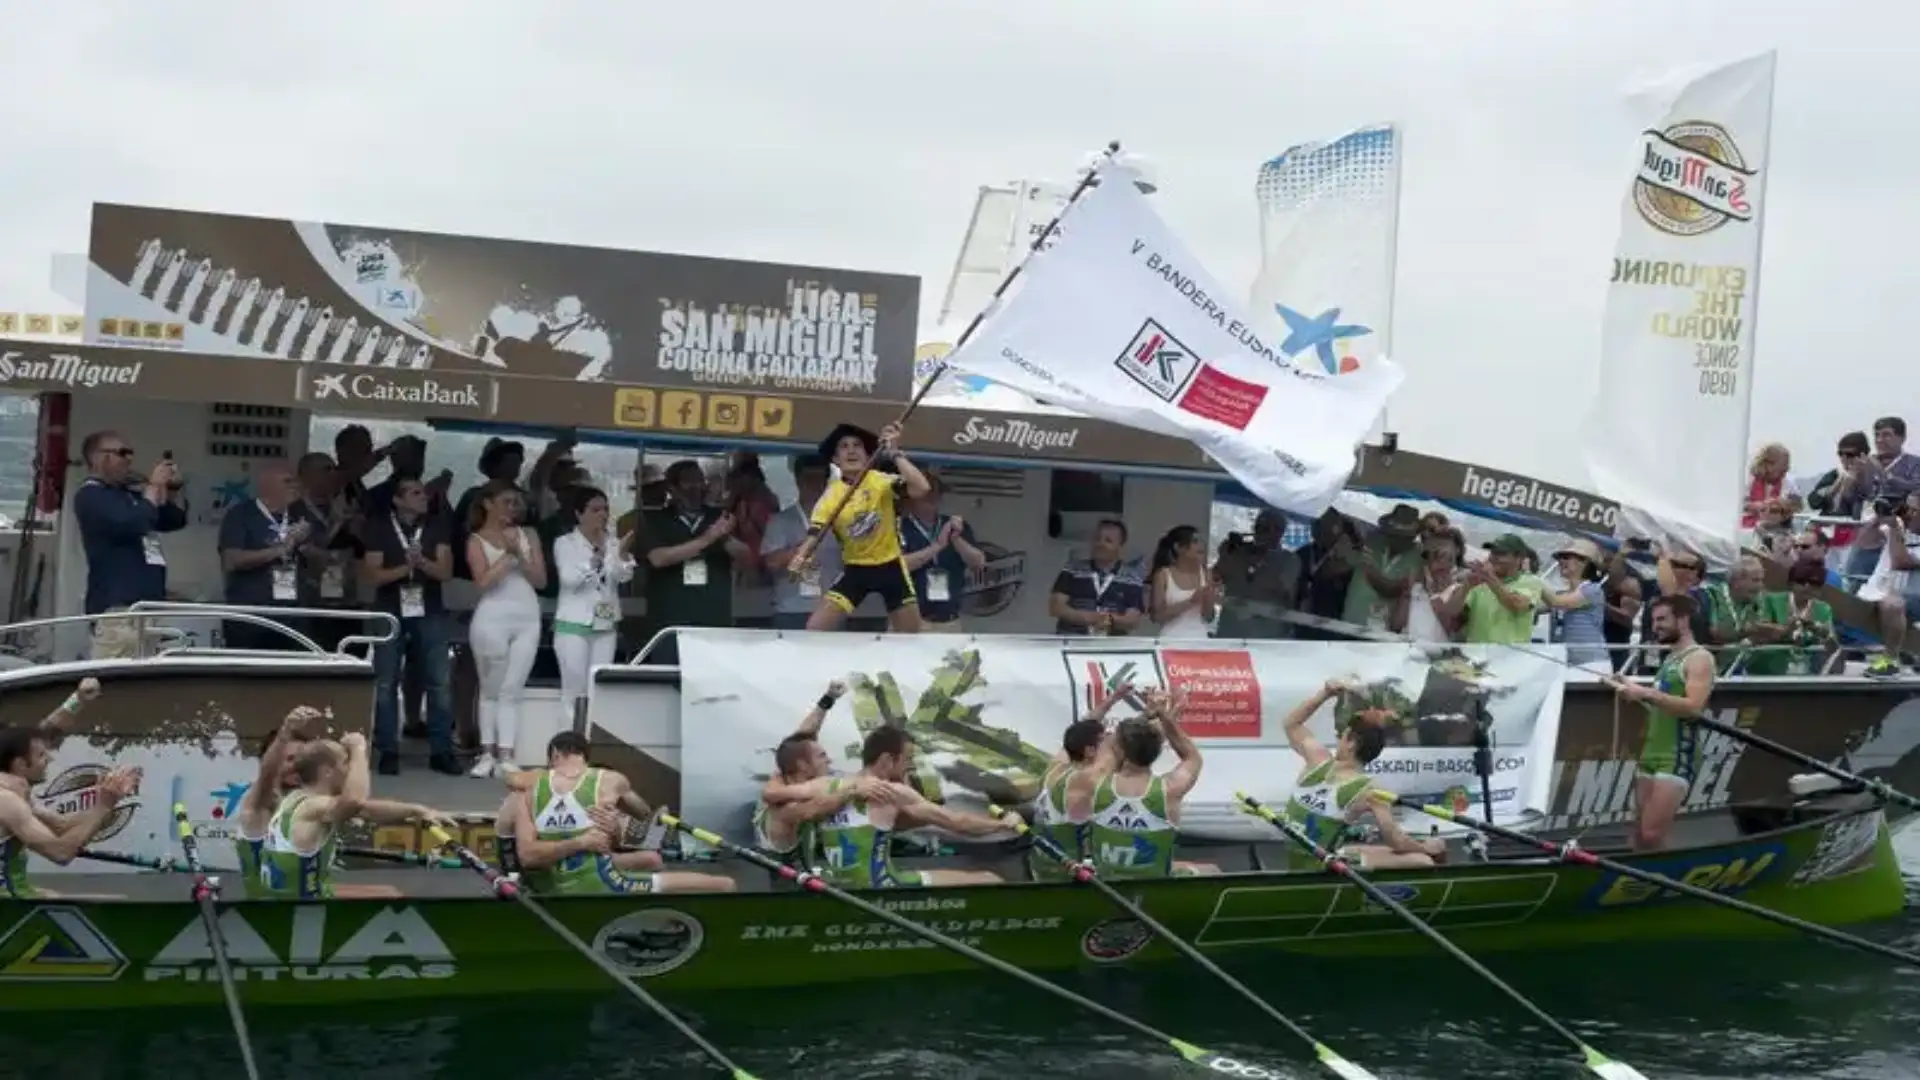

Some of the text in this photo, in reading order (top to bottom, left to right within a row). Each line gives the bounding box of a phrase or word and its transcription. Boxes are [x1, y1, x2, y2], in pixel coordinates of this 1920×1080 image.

[1146, 252, 1226, 327] BANDERA
[659, 308, 877, 361] SAN MIGUEL
[0, 351, 143, 388] SanMiguel
[657, 347, 749, 374] CORONA
[754, 354, 878, 384] CAIXABANK
[351, 374, 480, 405] CaixaBank
[952, 416, 1079, 451] SanMiguel
[545, 813, 577, 827] AIA
[150, 905, 458, 966] AIA
[144, 964, 460, 981] PINTURAS
